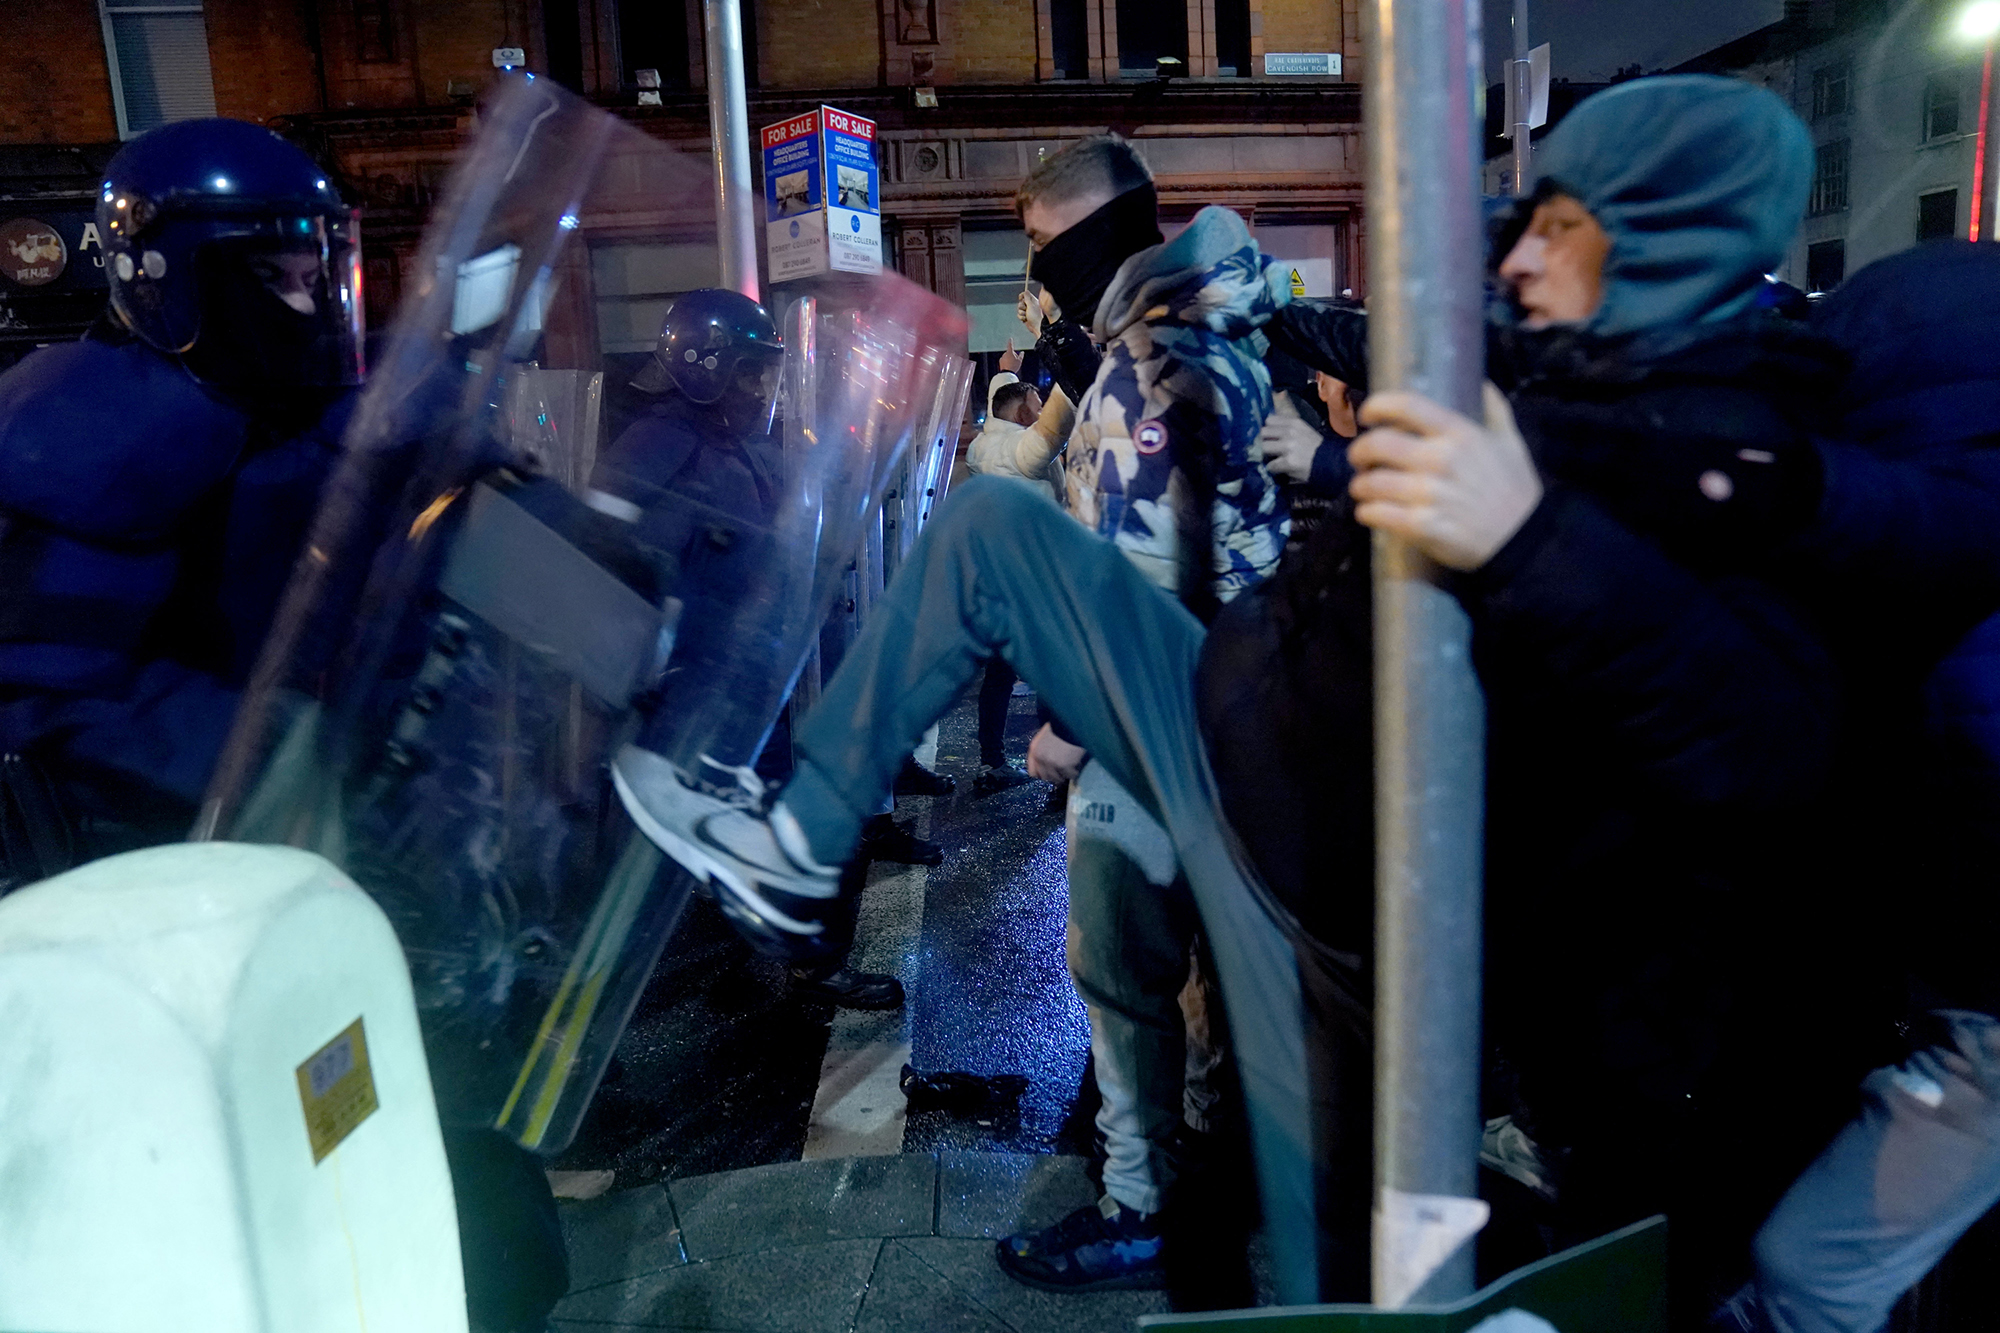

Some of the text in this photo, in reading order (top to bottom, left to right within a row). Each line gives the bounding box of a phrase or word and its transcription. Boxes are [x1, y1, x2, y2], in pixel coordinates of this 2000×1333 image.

[1332, 60, 1337, 69] 1
[768, 118, 812, 144] FOR SALE
[829, 113, 872, 138] FOR SALE
[773, 140, 808, 157] HEADQUARTERS
[835, 135, 868, 151] HEADQUARTERS
[772, 149, 810, 166] OFFICE BUILDING
[834, 144, 869, 160] OFFICE BUILDING
[832, 232, 879, 246] ROBERT COLLERAN
[771, 243, 791, 254] ROBERT
